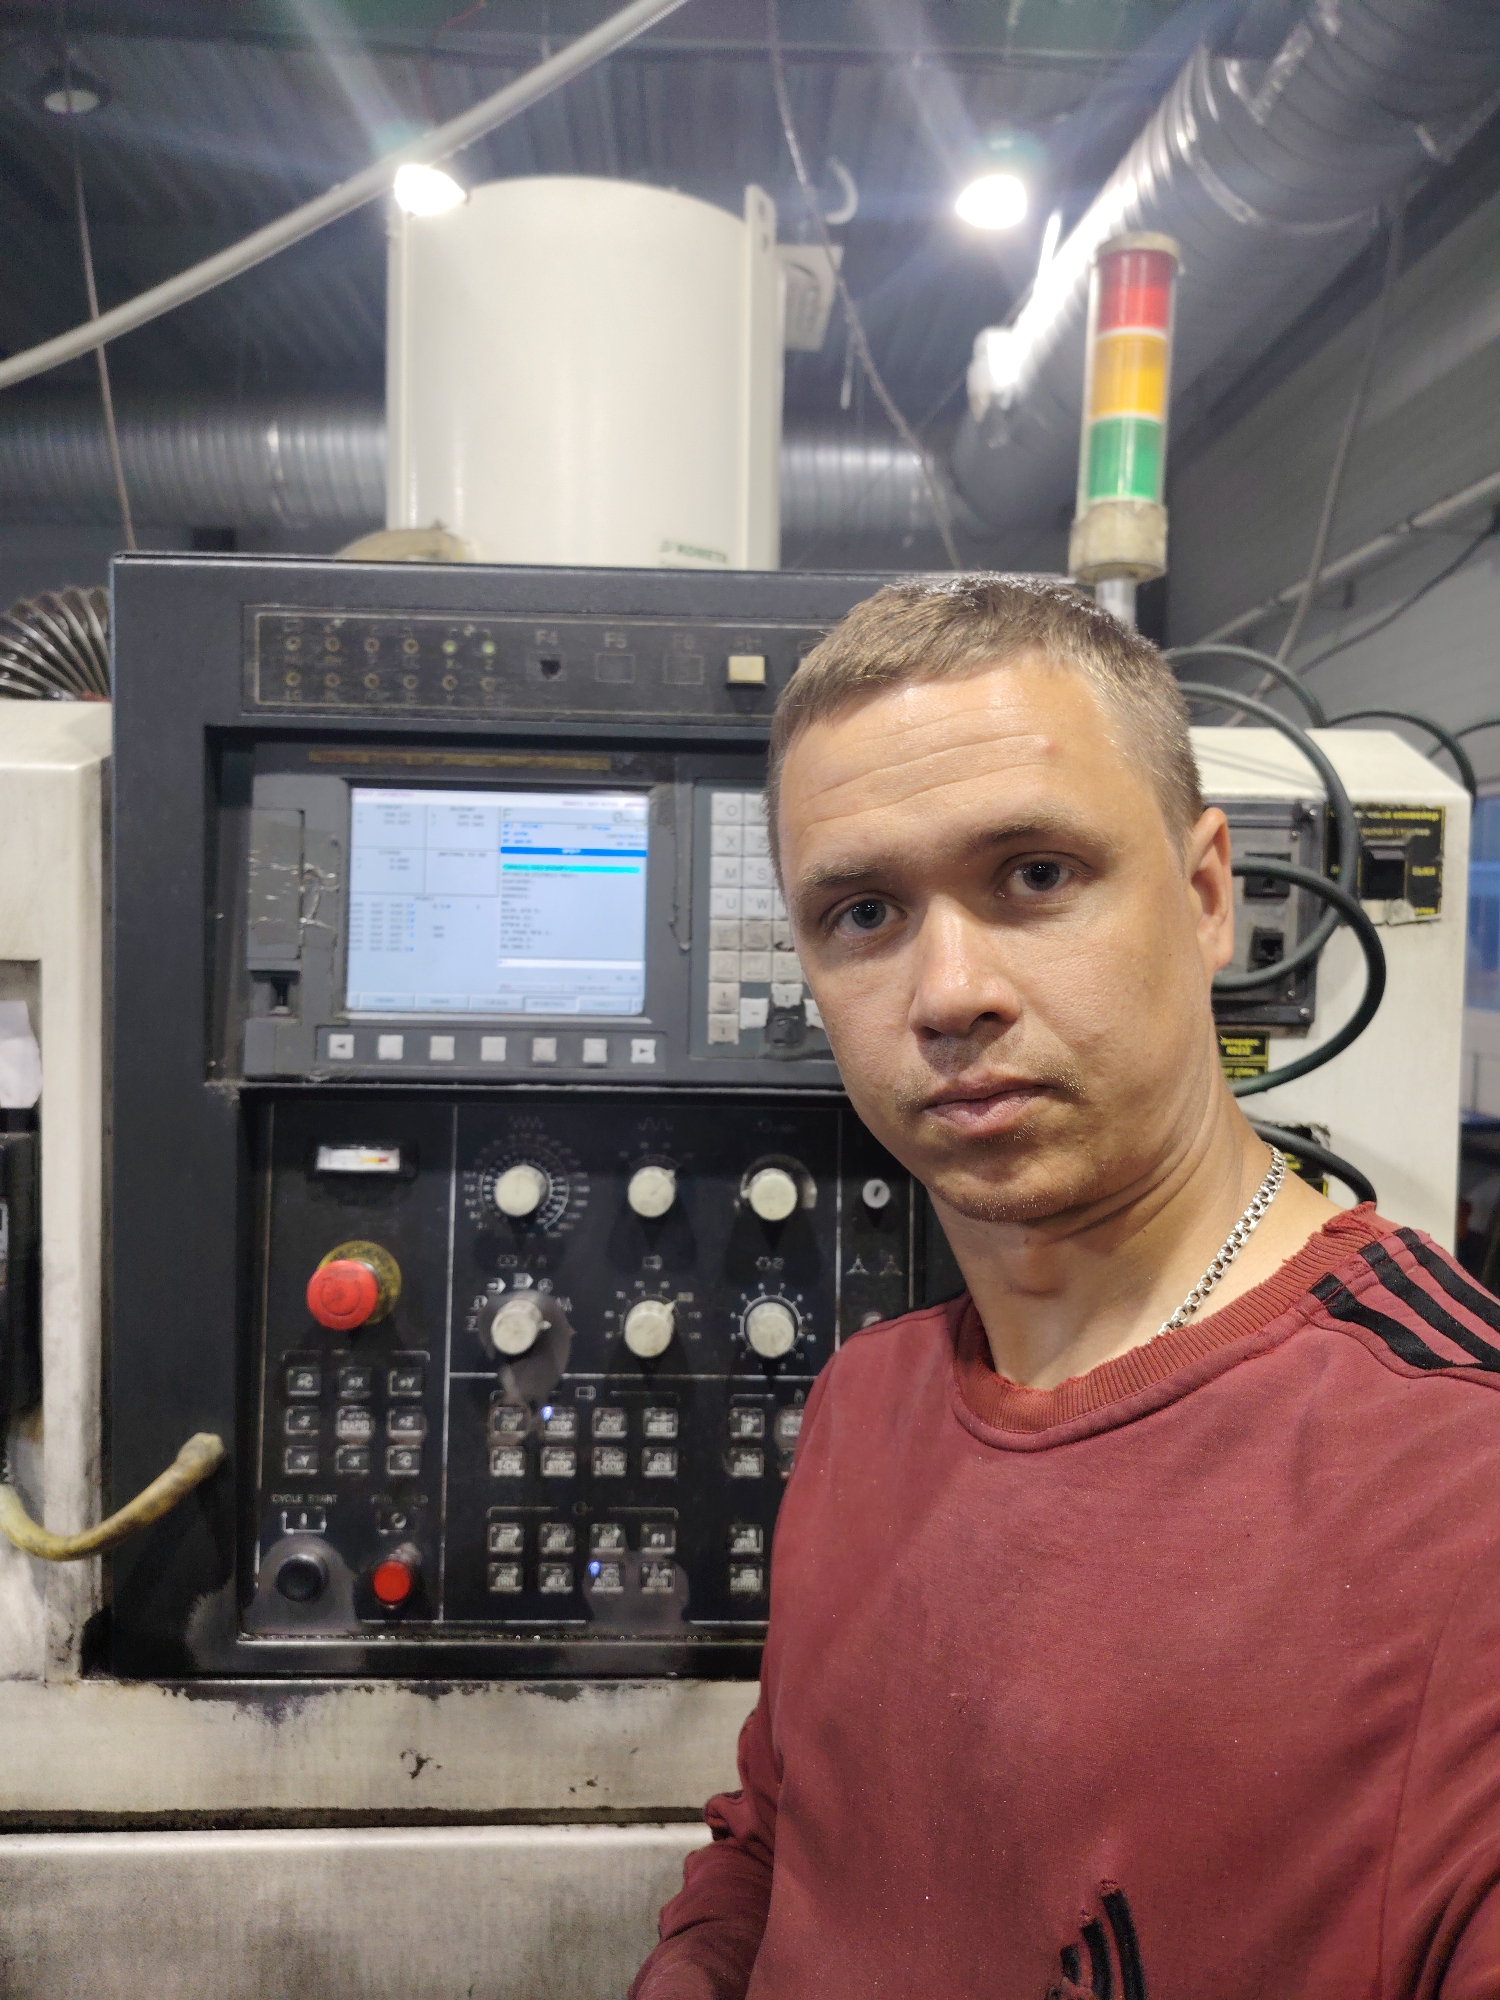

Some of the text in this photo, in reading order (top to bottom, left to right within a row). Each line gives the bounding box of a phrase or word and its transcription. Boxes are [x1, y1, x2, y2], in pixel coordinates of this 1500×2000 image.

[726, 836, 736, 849] X
[725, 867, 736, 879] M
[757, 868, 768, 880] S
[726, 898, 737, 910] U
[757, 898, 768, 910] W
[270, 1493, 302, 1504] CYCLE
